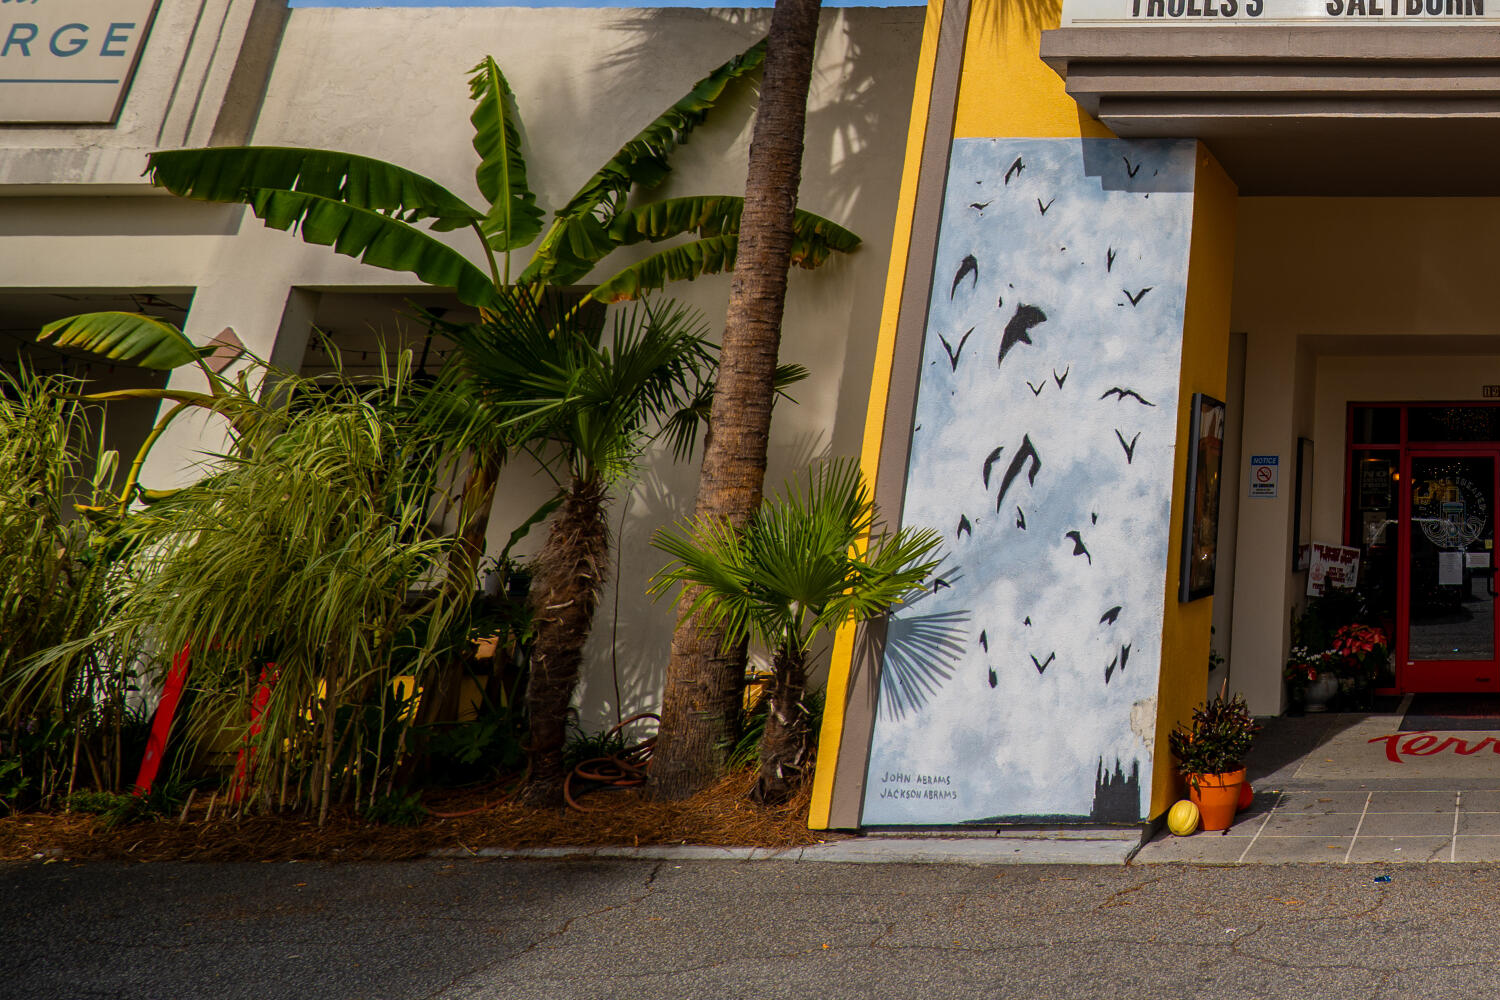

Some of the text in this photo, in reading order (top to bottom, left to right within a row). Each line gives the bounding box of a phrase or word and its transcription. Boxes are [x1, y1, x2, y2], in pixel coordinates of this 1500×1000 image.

[0, 22, 136, 57] RGE
[881, 771, 951, 785] JOHN ABRAMS
[880, 788, 957, 800] JACKSON ABRAMS
